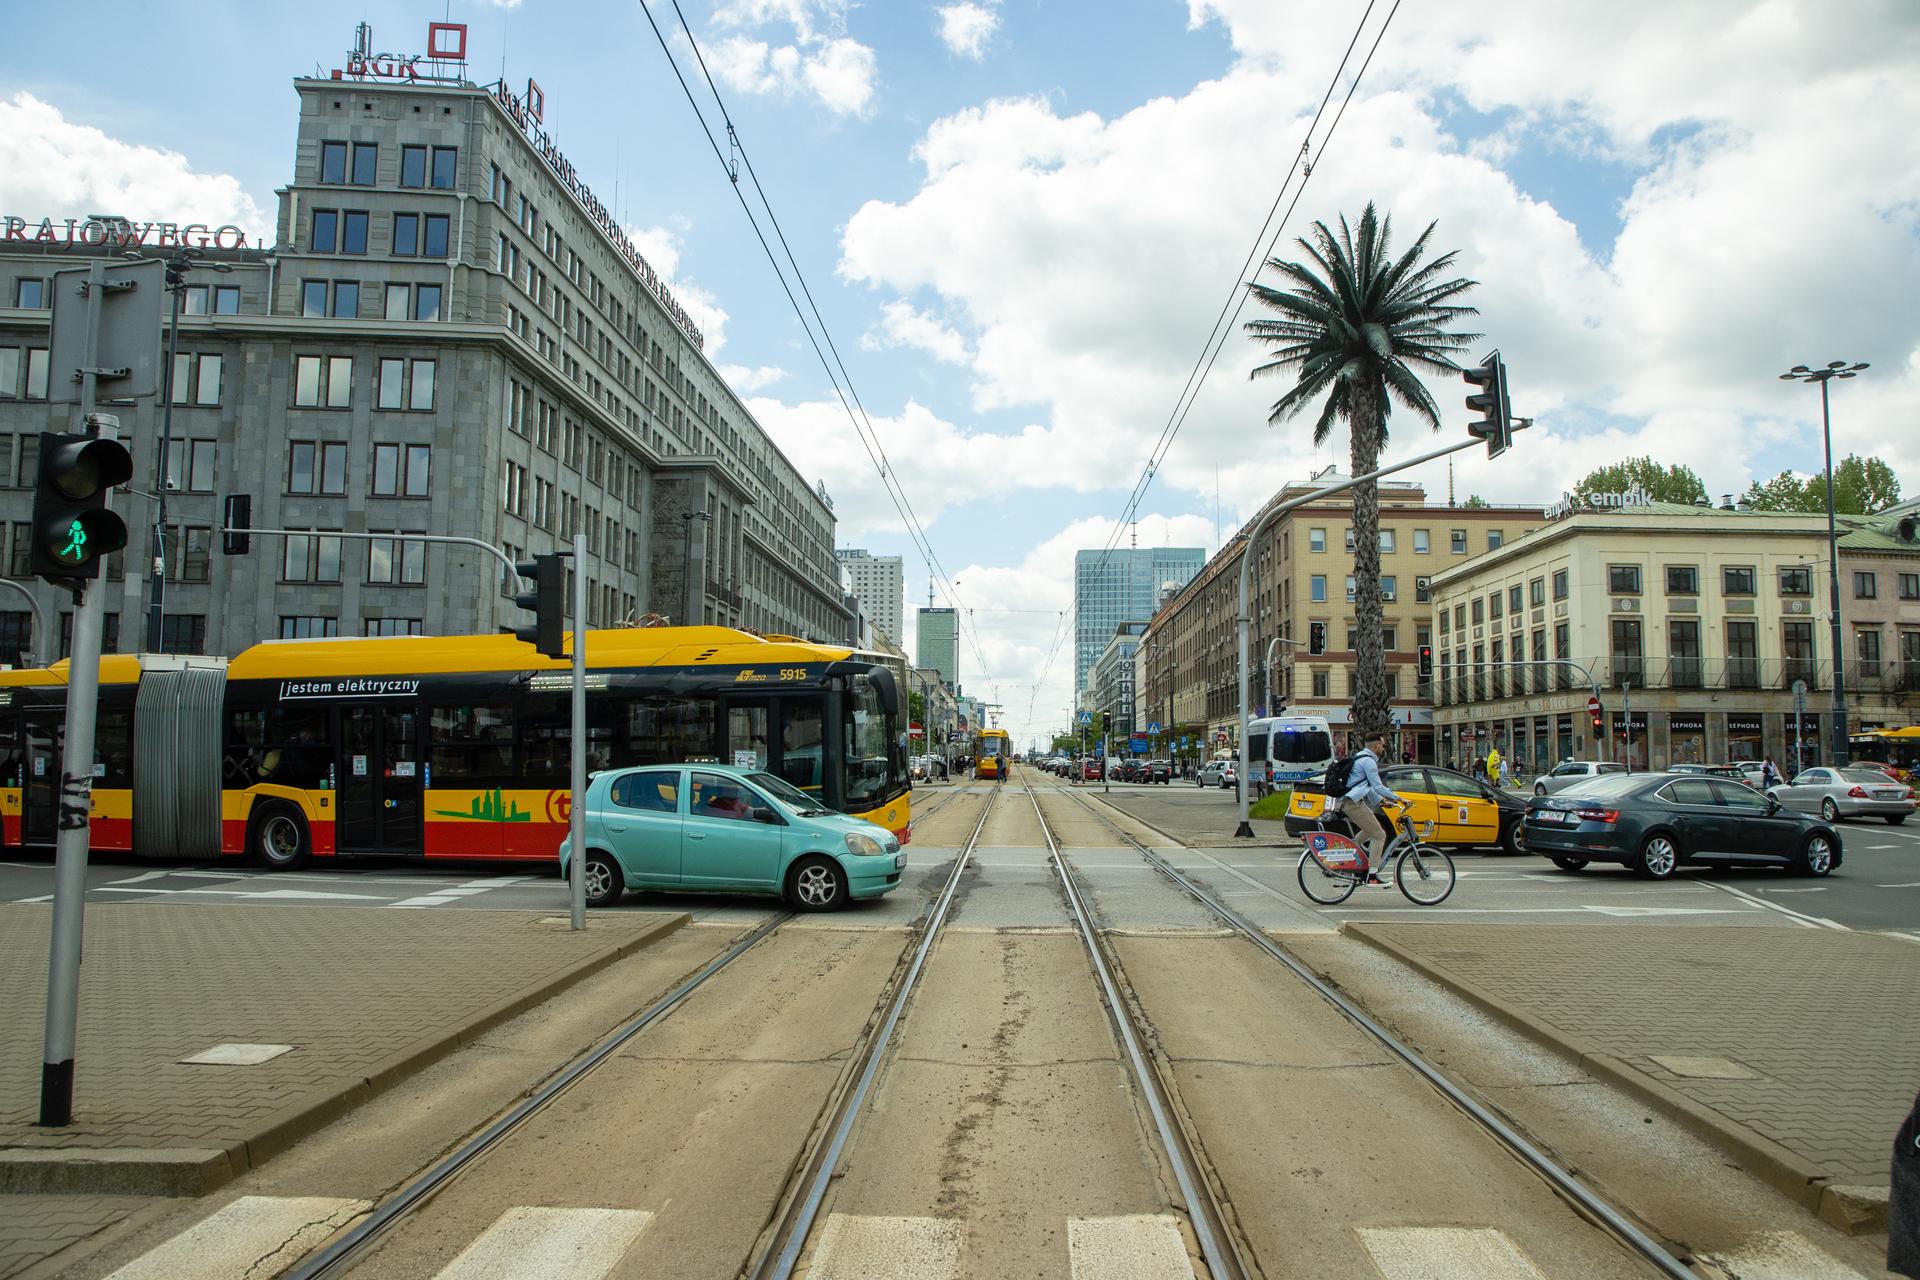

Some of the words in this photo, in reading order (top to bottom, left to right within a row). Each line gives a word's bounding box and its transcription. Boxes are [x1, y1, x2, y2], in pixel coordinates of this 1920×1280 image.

[347, 51, 421, 79] BGK
[499, 78, 526, 130] BGK
[542, 131, 577, 193] BANK
[1543, 491, 1573, 520] empik
[1590, 488, 1654, 510] empik
[779, 668, 807, 681] 5915
[285, 681, 333, 697] jestem
[336, 678, 421, 693] elektryczny
[1613, 721, 1646, 729] SEPORA
[1671, 722, 1703, 730] SEPHORA
[1728, 722, 1761, 730] SEPHORA
[1275, 772, 1302, 780] POLICJA
